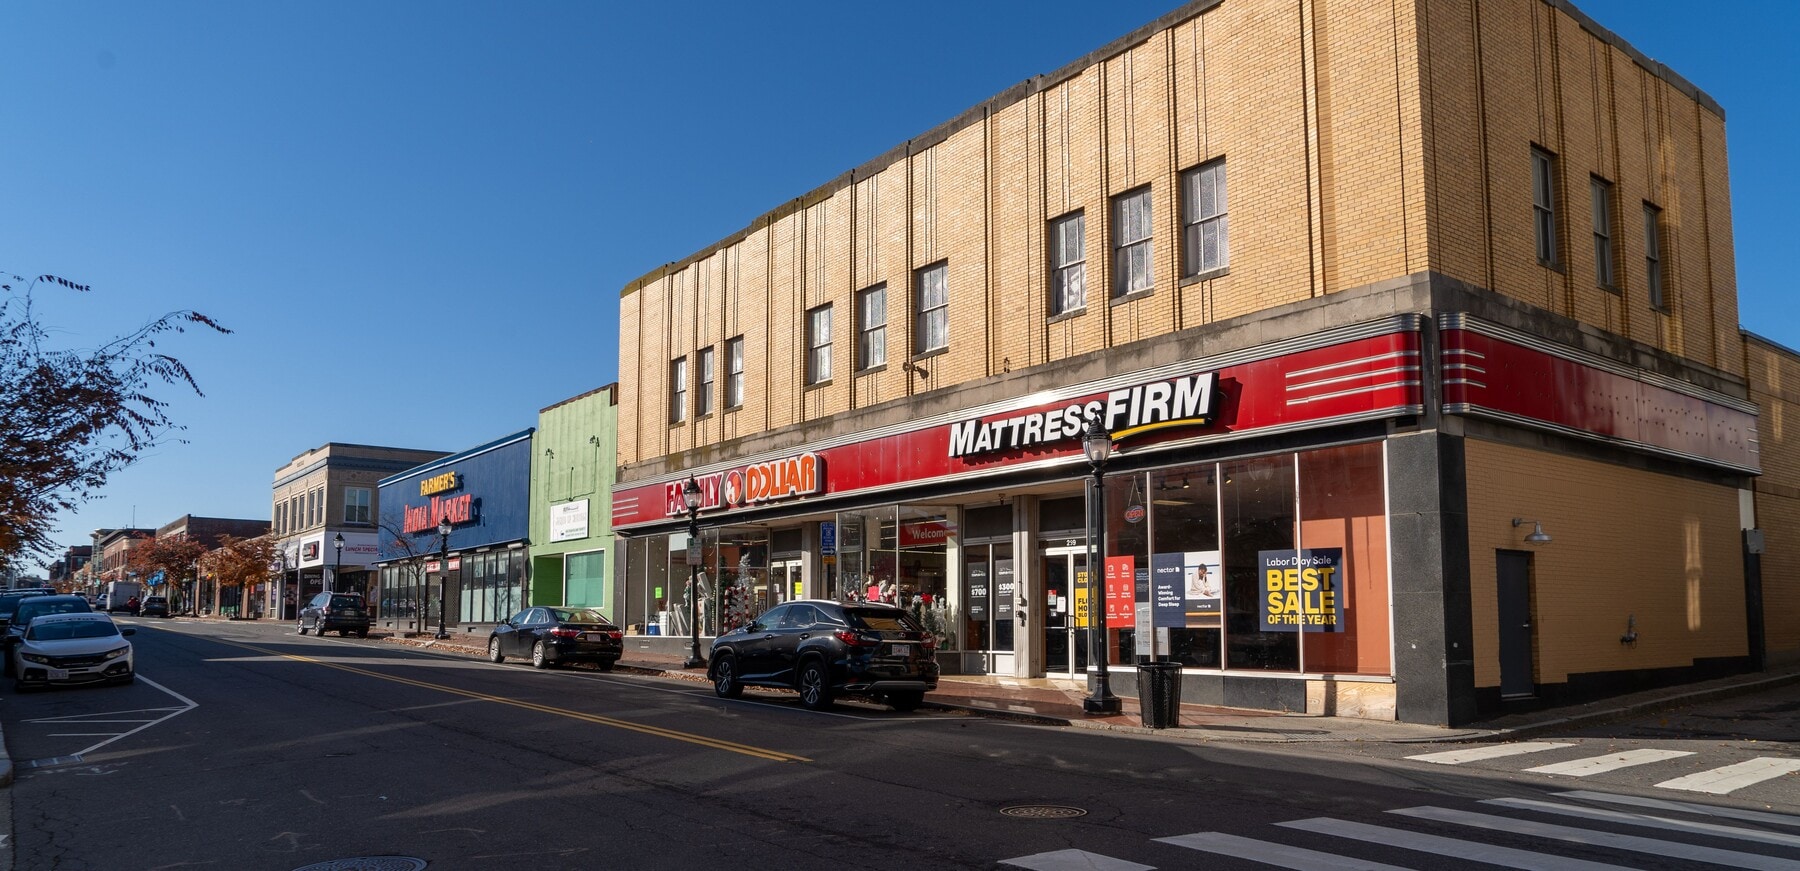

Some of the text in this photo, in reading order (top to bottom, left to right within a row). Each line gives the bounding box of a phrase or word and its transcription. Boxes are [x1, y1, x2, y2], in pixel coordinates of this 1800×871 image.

[420, 471, 455, 497] FARMER'S
[665, 453, 817, 516] FAILY DOLLAR
[403, 494, 471, 534] INDIA MARKET
[912, 528, 946, 540] Welcom
[1266, 555, 1332, 567] Labor Day Sale
[998, 583, 1015, 591] $300
[1266, 567, 1335, 592] BEST
[971, 588, 987, 596] $700
[1267, 591, 1336, 615] SALE
[1267, 615, 1337, 625] OF THE YEAR
